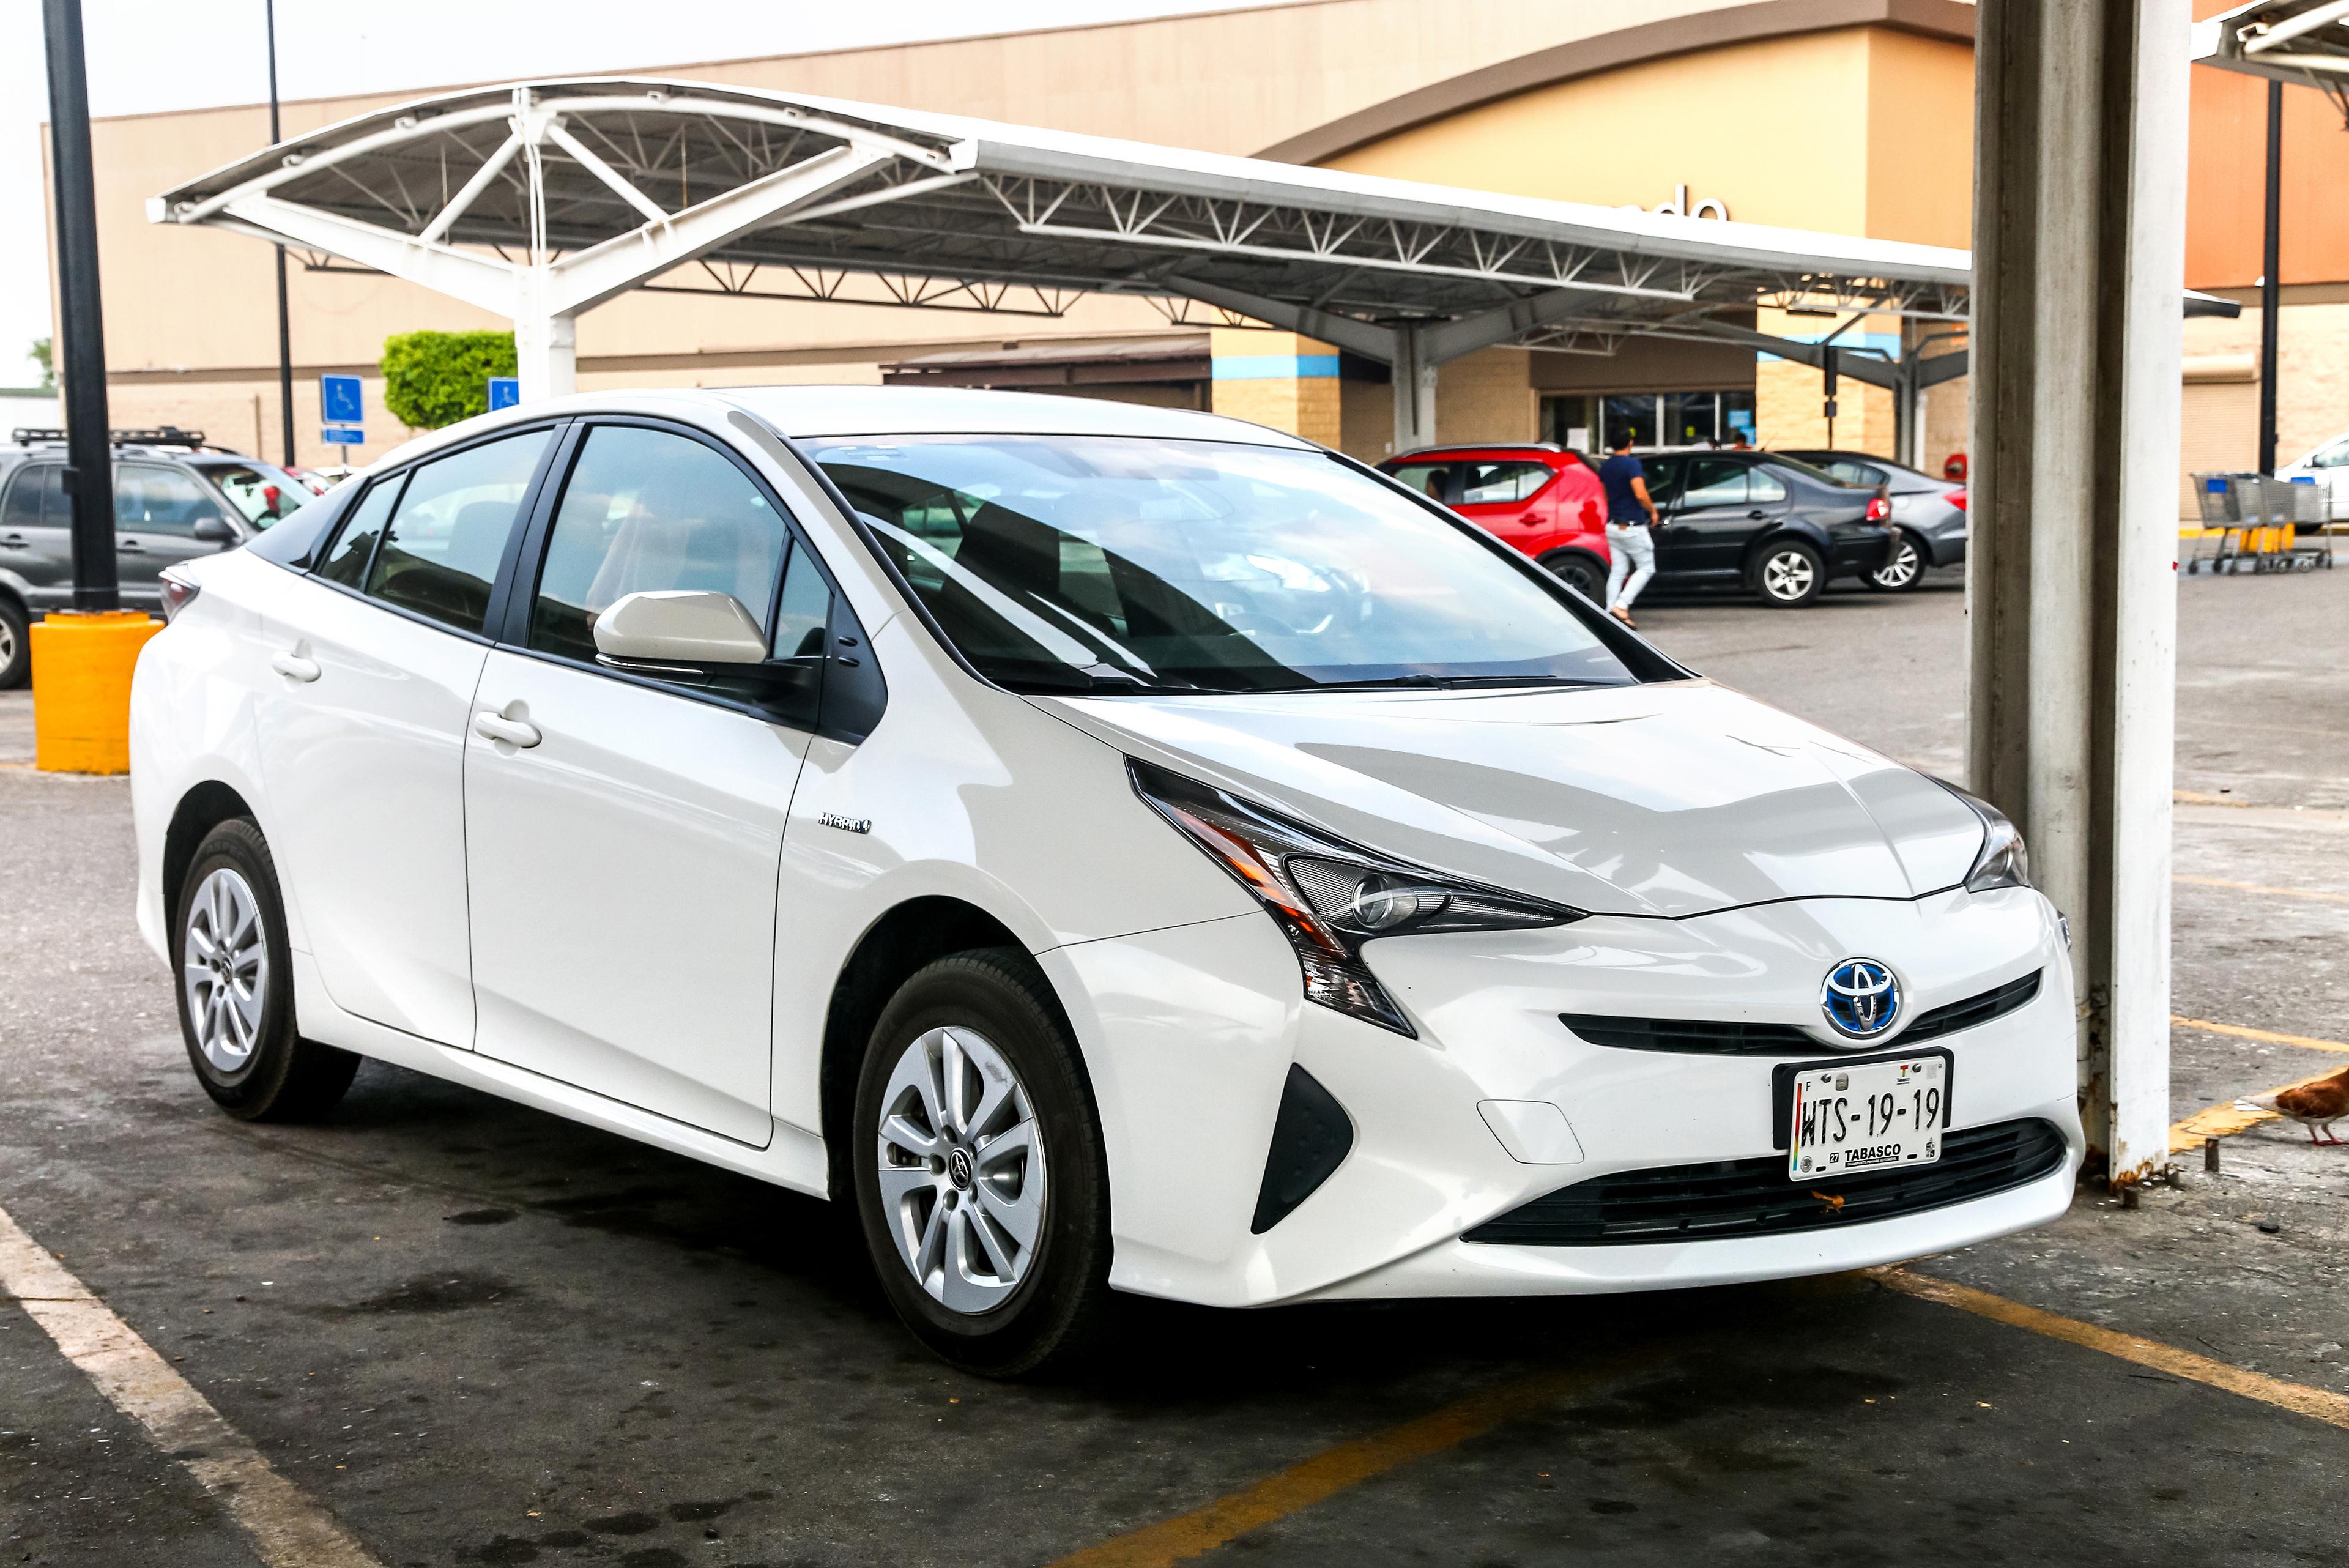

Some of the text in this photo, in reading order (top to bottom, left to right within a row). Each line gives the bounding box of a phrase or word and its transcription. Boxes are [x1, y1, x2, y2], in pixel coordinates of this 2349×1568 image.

[1806, 1081, 1811, 1092] F
[1801, 1087, 1939, 1147] WTS-19-19
[1830, 1153, 1839, 1162] 27
[1844, 1143, 1901, 1161] TABASCO
